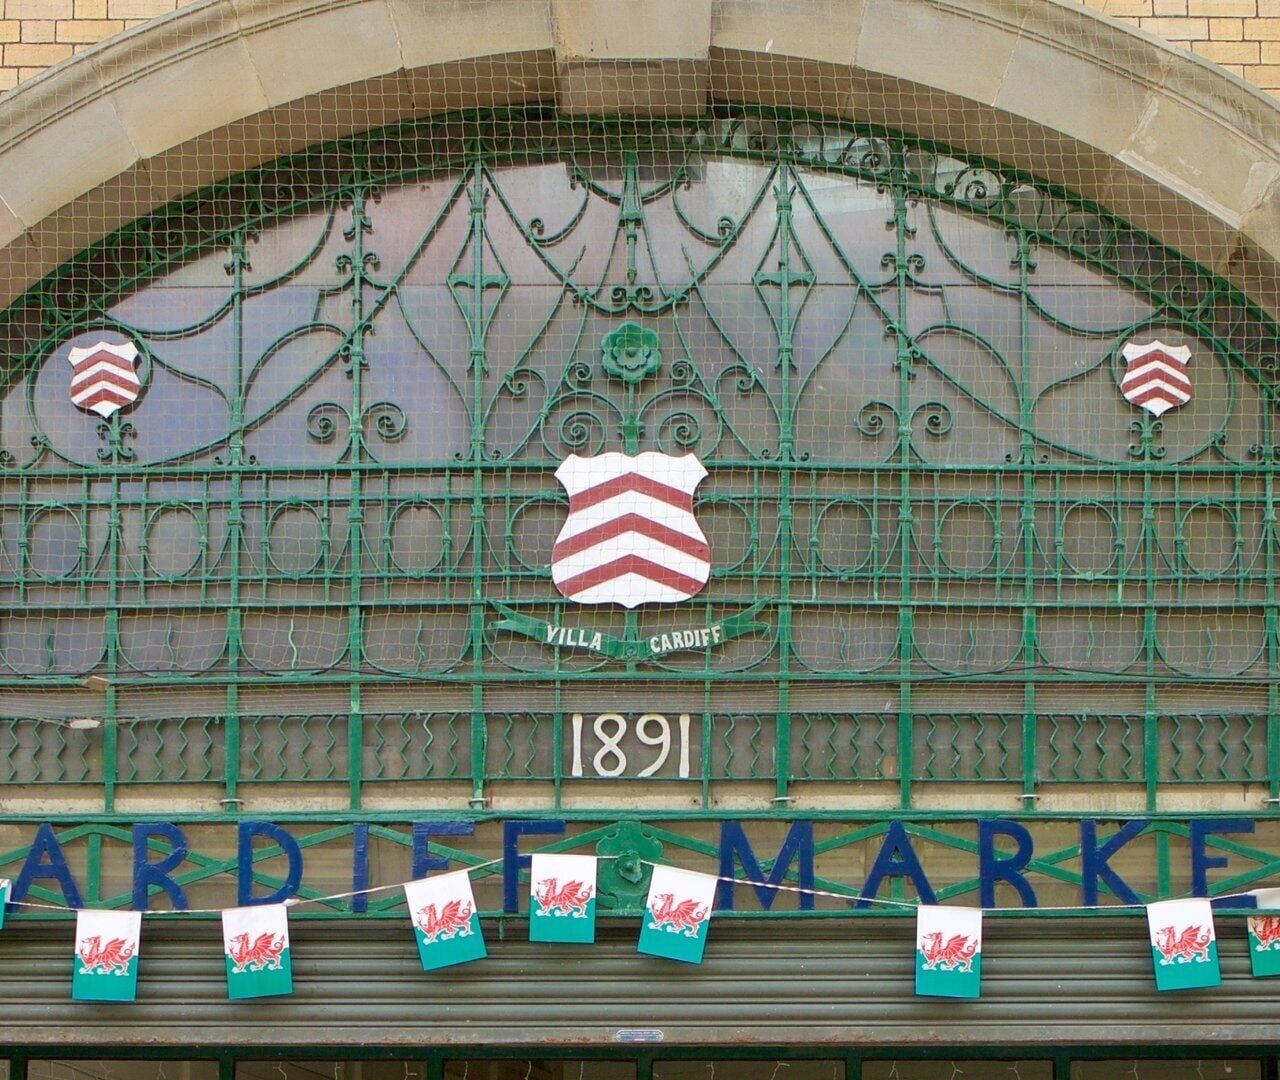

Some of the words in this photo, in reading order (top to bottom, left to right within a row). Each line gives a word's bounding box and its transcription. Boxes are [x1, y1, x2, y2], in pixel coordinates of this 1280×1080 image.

[546, 625, 602, 650] VILLA
[650, 624, 721, 653] CARDIFF
[572, 713, 690, 778] 1891
